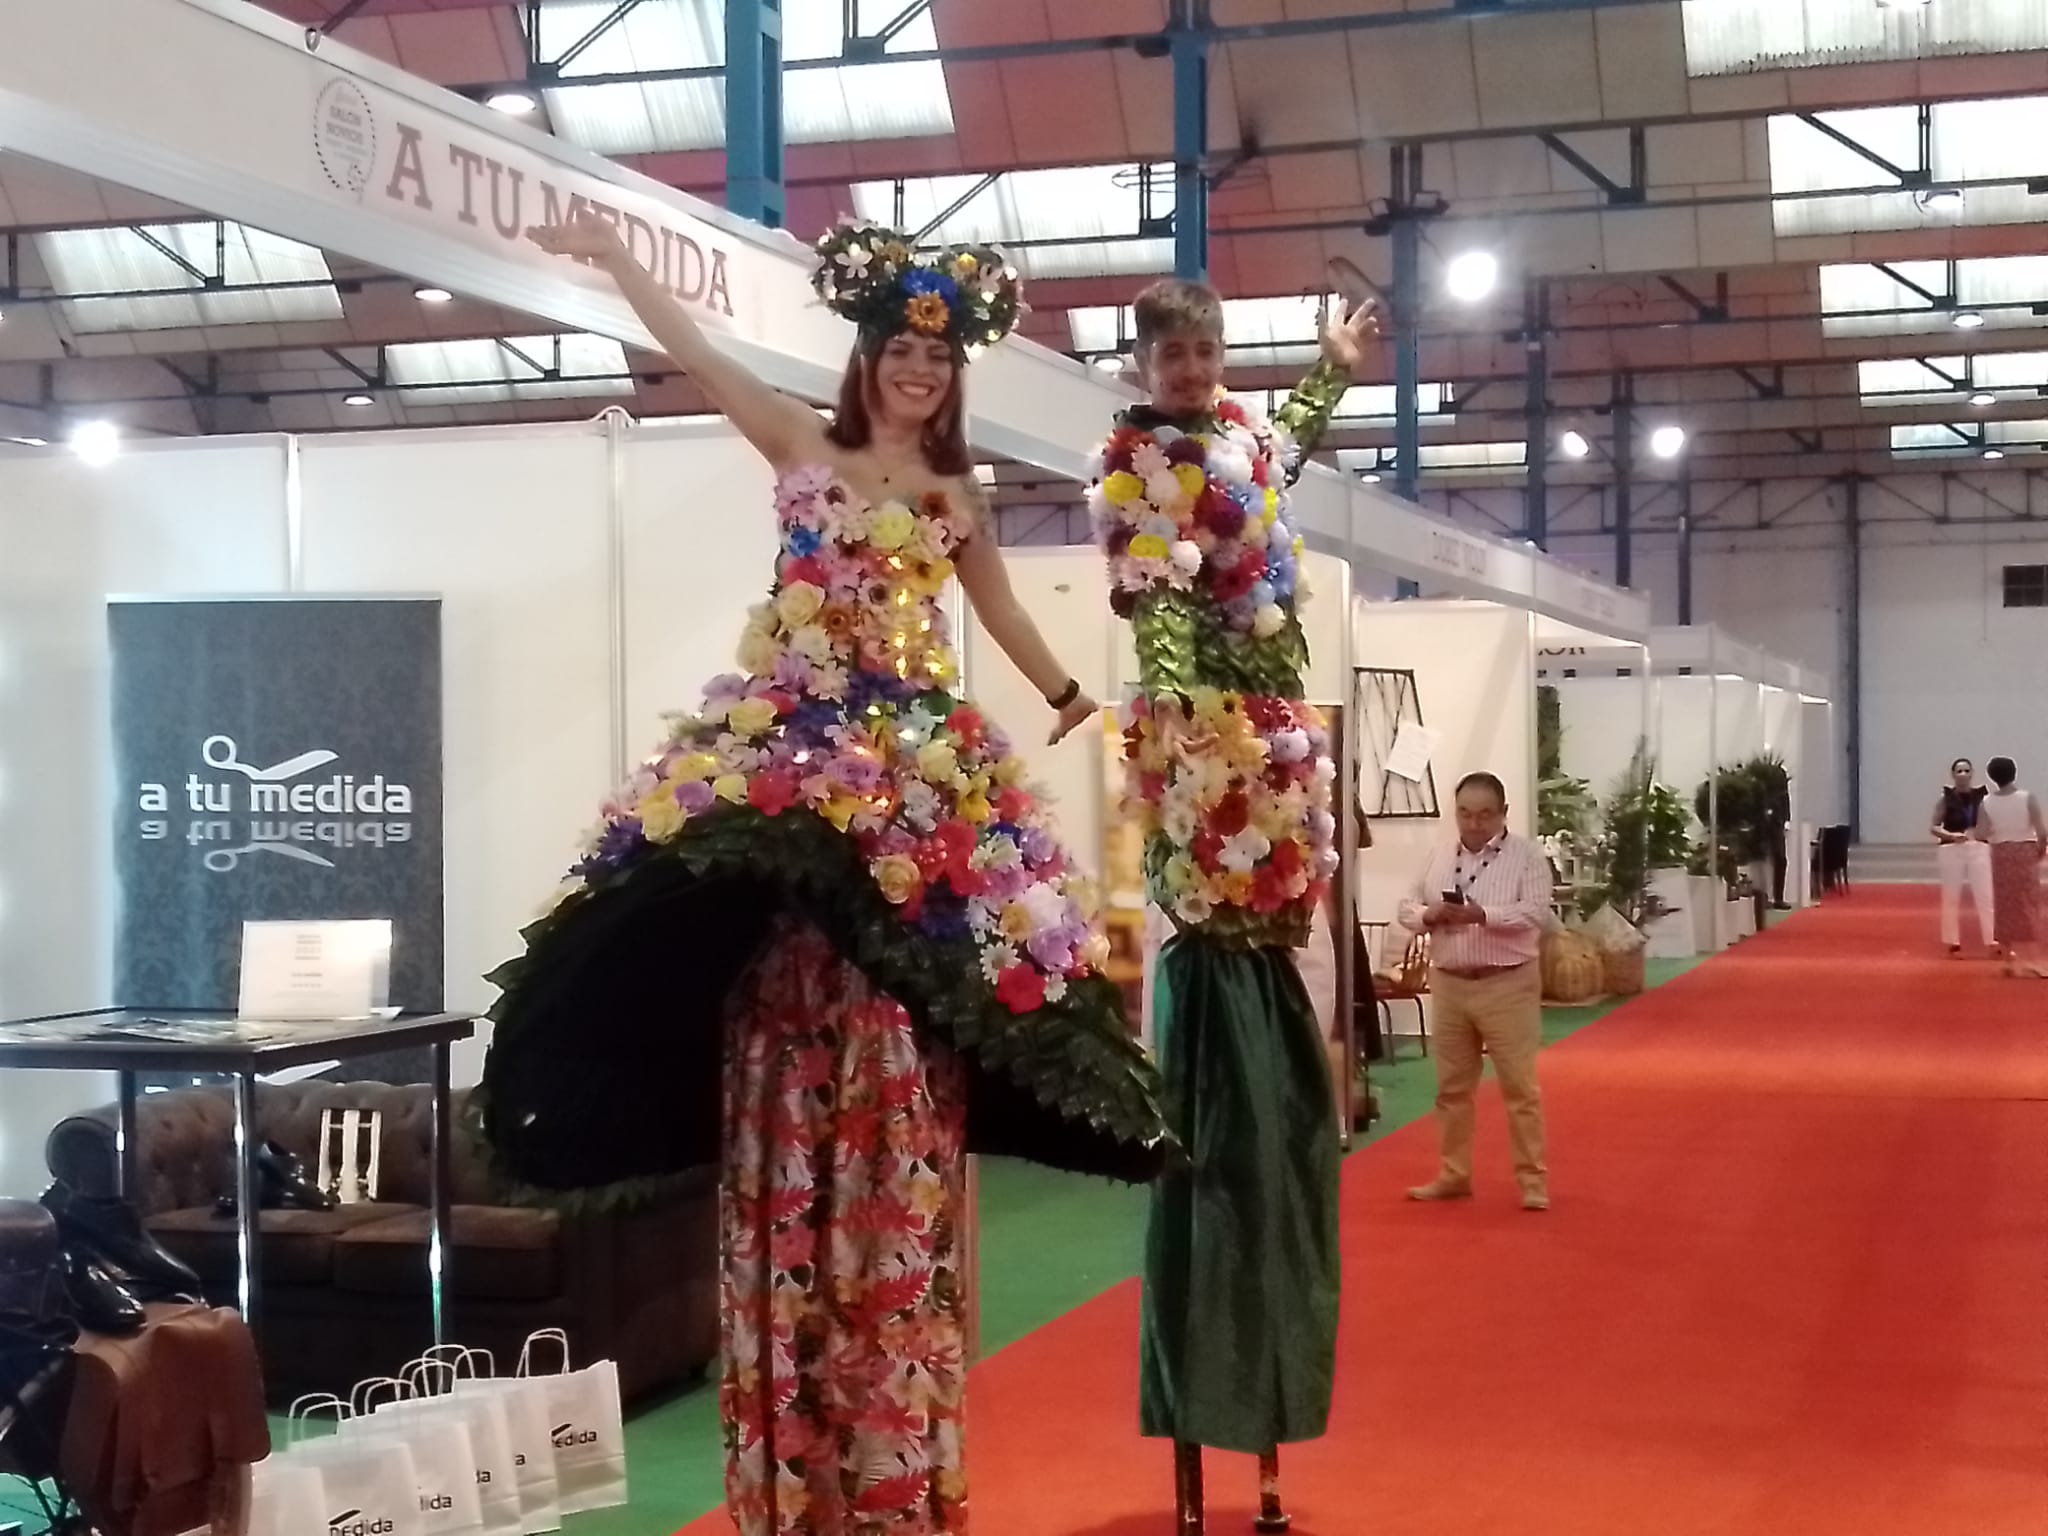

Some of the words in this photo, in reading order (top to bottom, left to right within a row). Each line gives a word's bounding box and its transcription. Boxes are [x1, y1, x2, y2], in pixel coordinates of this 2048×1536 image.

[386, 123, 432, 211] A
[449, 143, 524, 240] TU
[139, 782, 168, 812] a
[185, 774, 230, 812] tu
[250, 775, 412, 813] medida
[552, 1430, 597, 1448] edida
